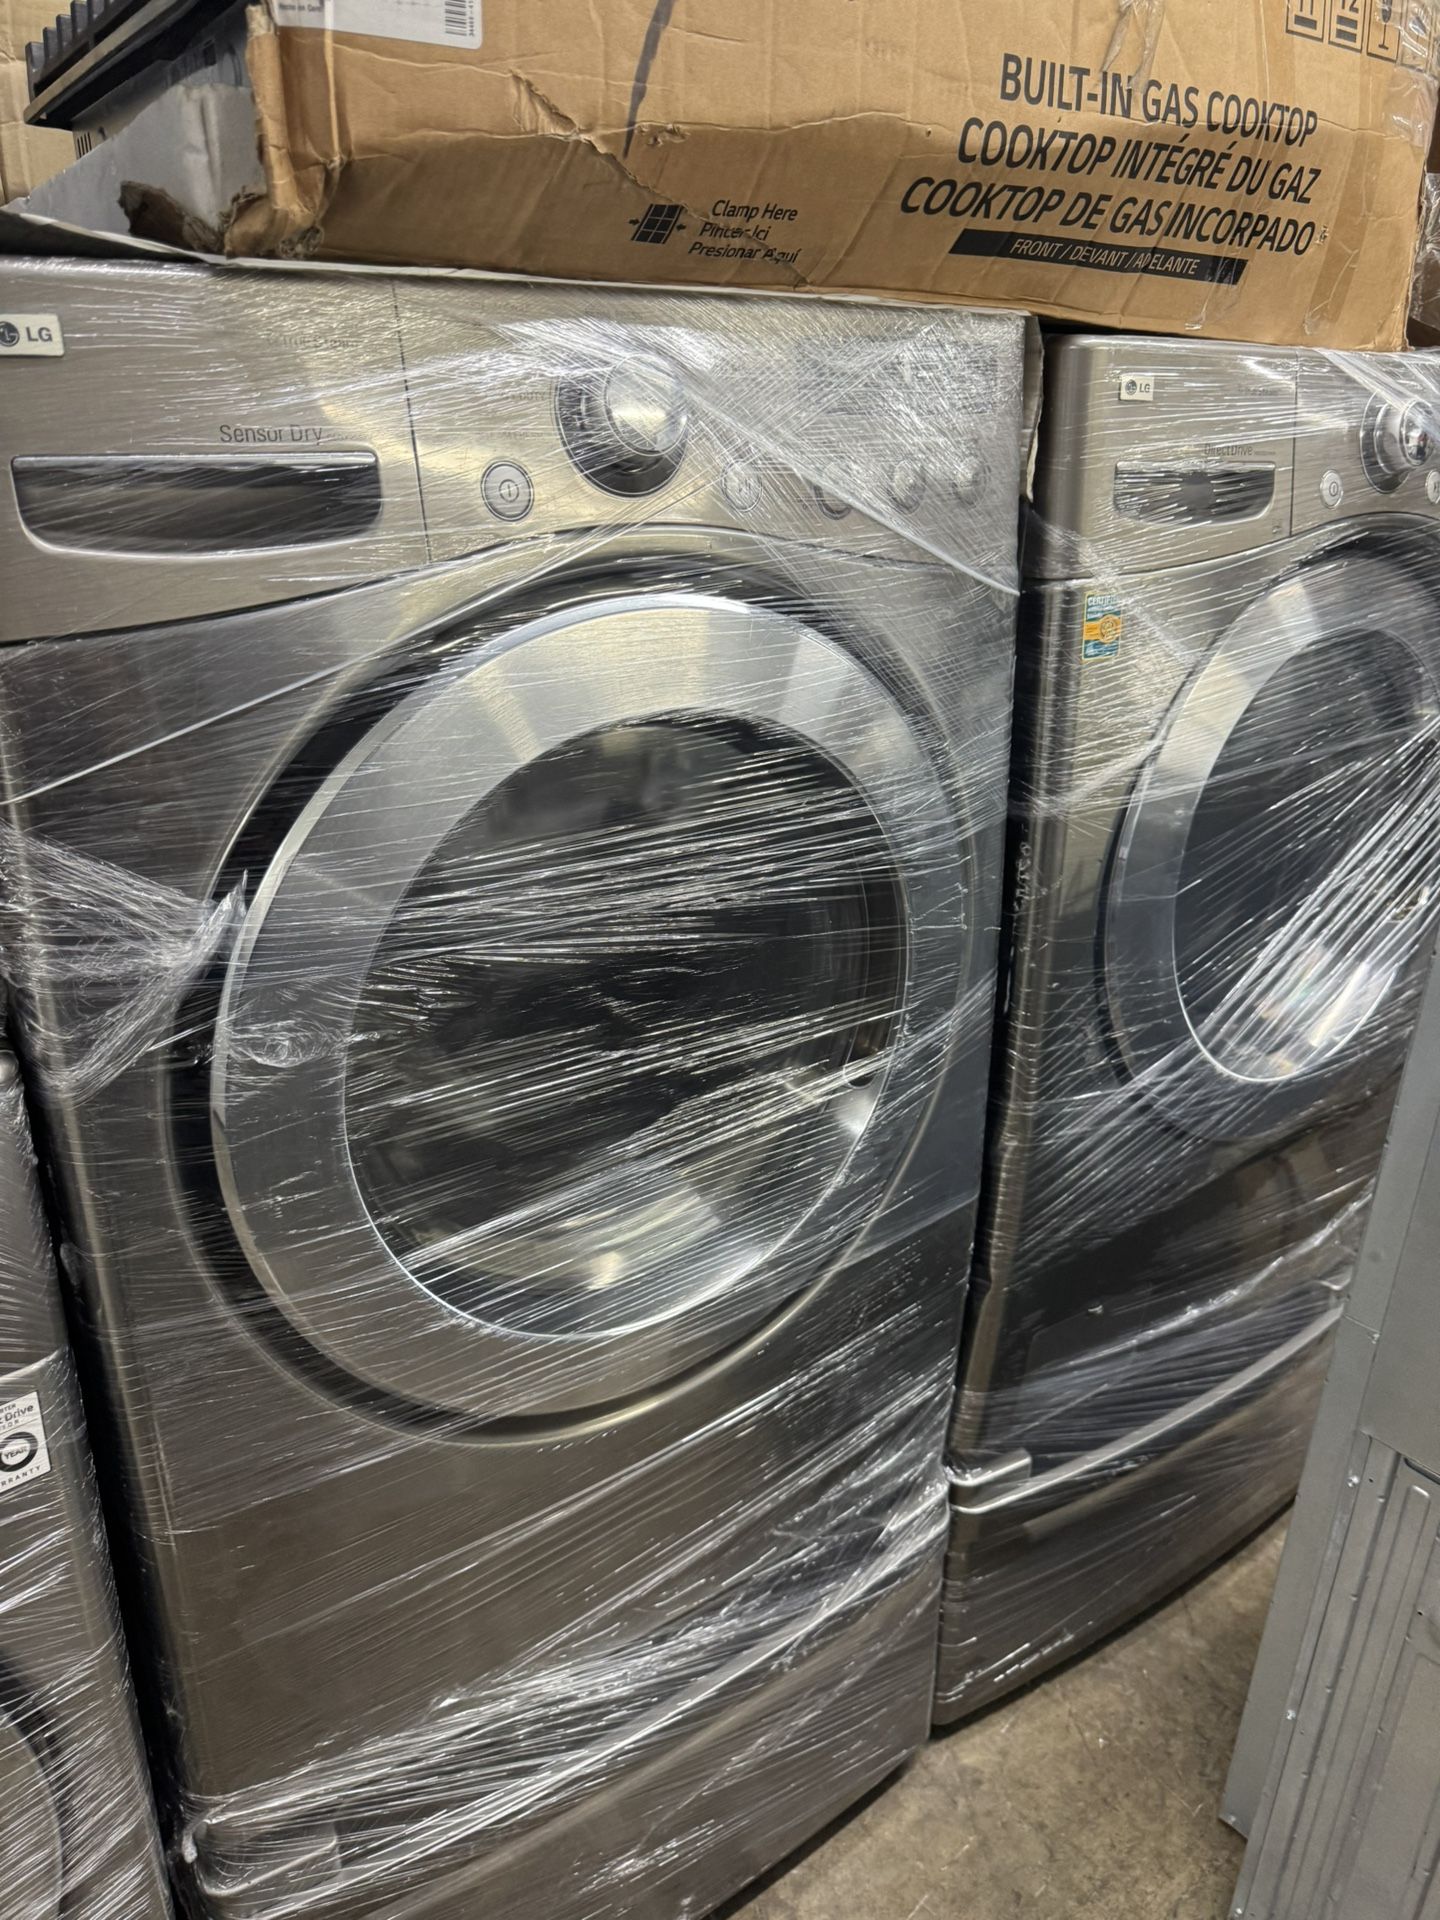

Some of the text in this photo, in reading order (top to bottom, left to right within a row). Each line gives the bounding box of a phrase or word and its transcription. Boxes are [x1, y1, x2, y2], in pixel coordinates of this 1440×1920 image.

[1000, 53, 1318, 147] BUILT-IN GAS COOKTOP
[958, 117, 1322, 204] COOKTOP INTÉGRÉ DU GAZ
[711, 199, 798, 223] Clamp Here
[901, 177, 1316, 256] COOKTOP DE GAS INCORPADO
[687, 241, 759, 260] Presionar
[1009, 238, 1060, 258] FRONT
[1070, 245, 1126, 268] DEVANT
[1135, 251, 1201, 275] ADELANTE
[25, 326, 53, 342] LG
[1138, 383, 1151, 394] LG
[219, 424, 283, 443] Sensor
[289, 424, 322, 446] Dry
[5, 1404, 34, 1422] Drive
[4, 1446, 28, 1460] YEAR
[1, 1465, 41, 1486] RRANTY
